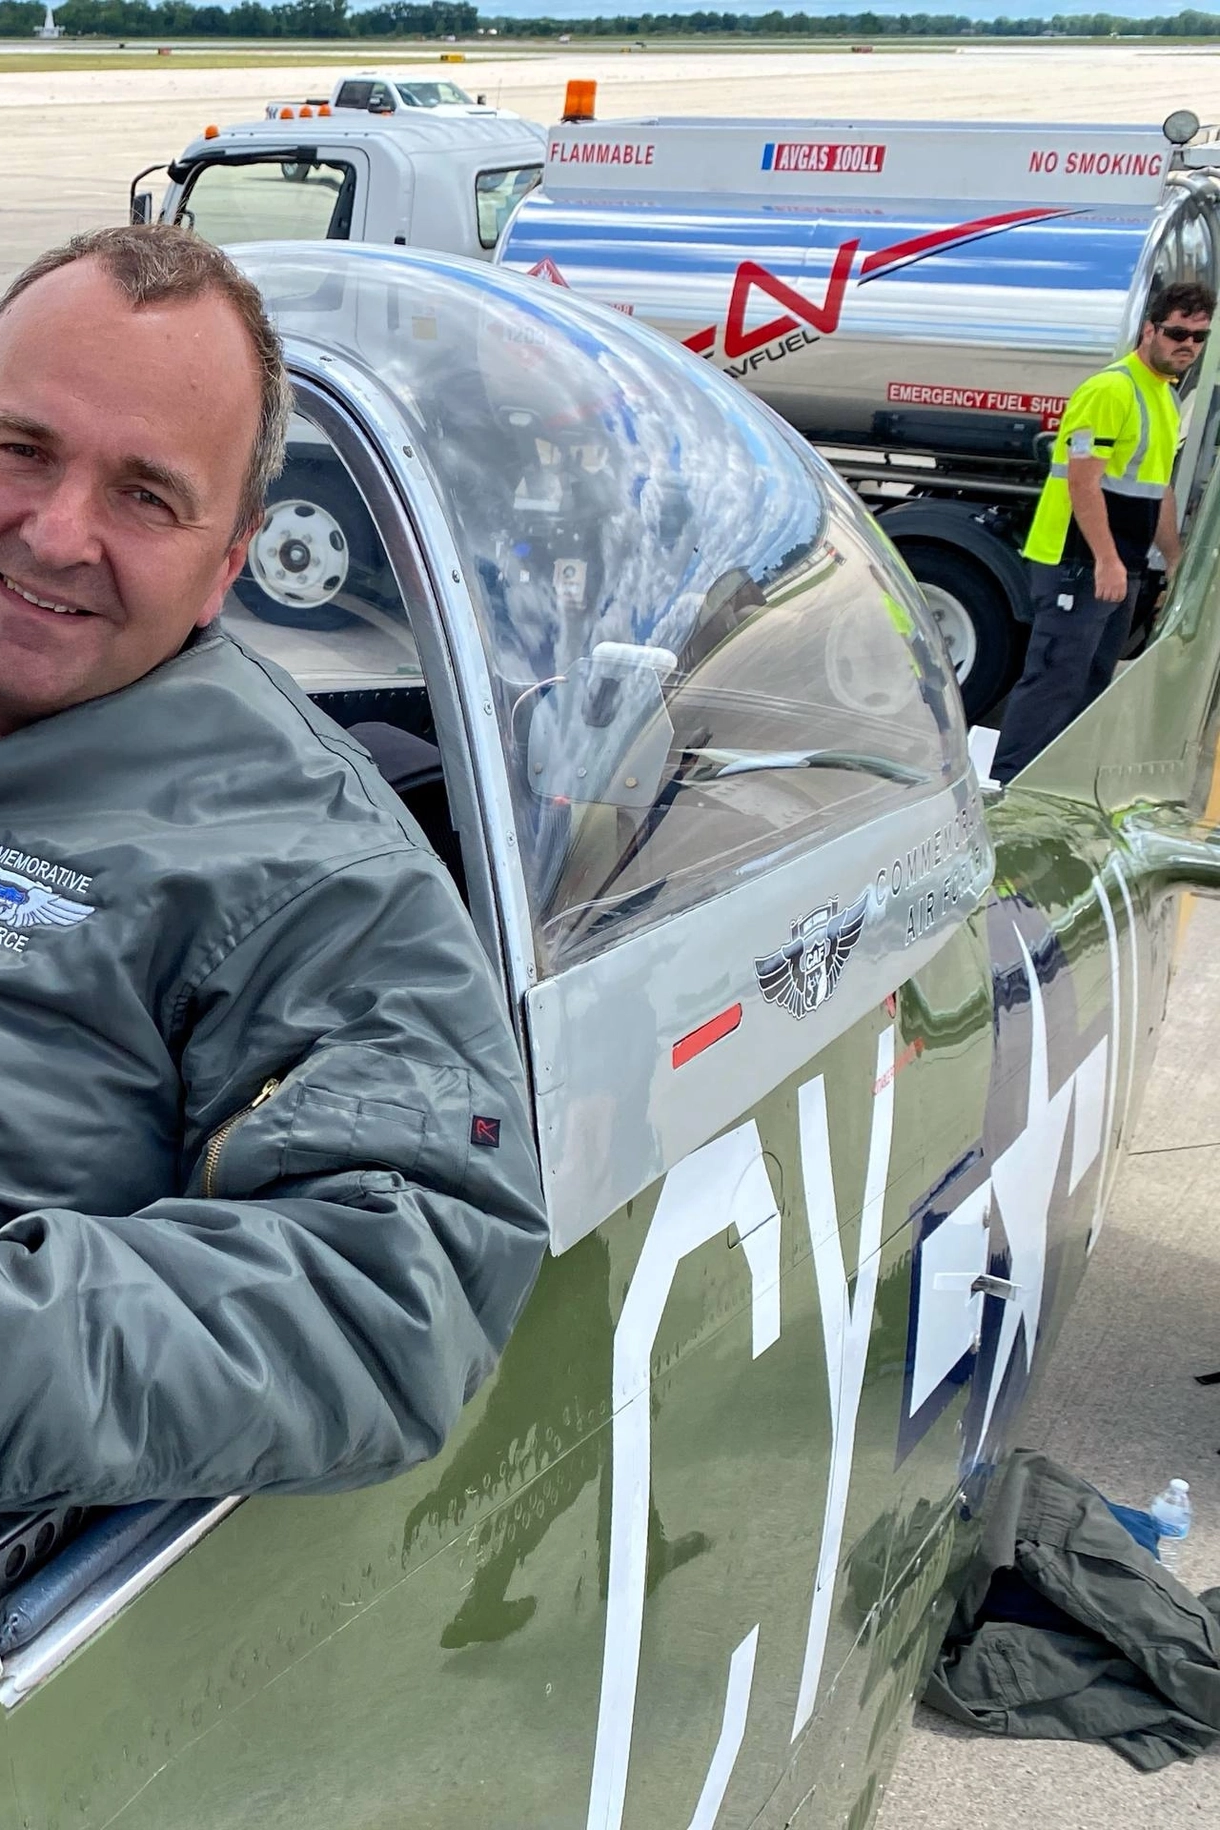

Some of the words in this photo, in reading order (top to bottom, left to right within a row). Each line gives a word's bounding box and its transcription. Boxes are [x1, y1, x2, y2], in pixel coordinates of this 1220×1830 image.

[550, 143, 655, 165] FLAMMABLE
[778, 145, 829, 170] AVGAS
[833, 146, 879, 171] 100LL
[1029, 151, 1059, 173] NO
[1065, 152, 1163, 176] SMOKING
[889, 384, 985, 408] EMERGENCY
[987, 393, 1028, 412] FUEL
[904, 890, 936, 946] AIR
[806, 945, 826, 970] CAF
